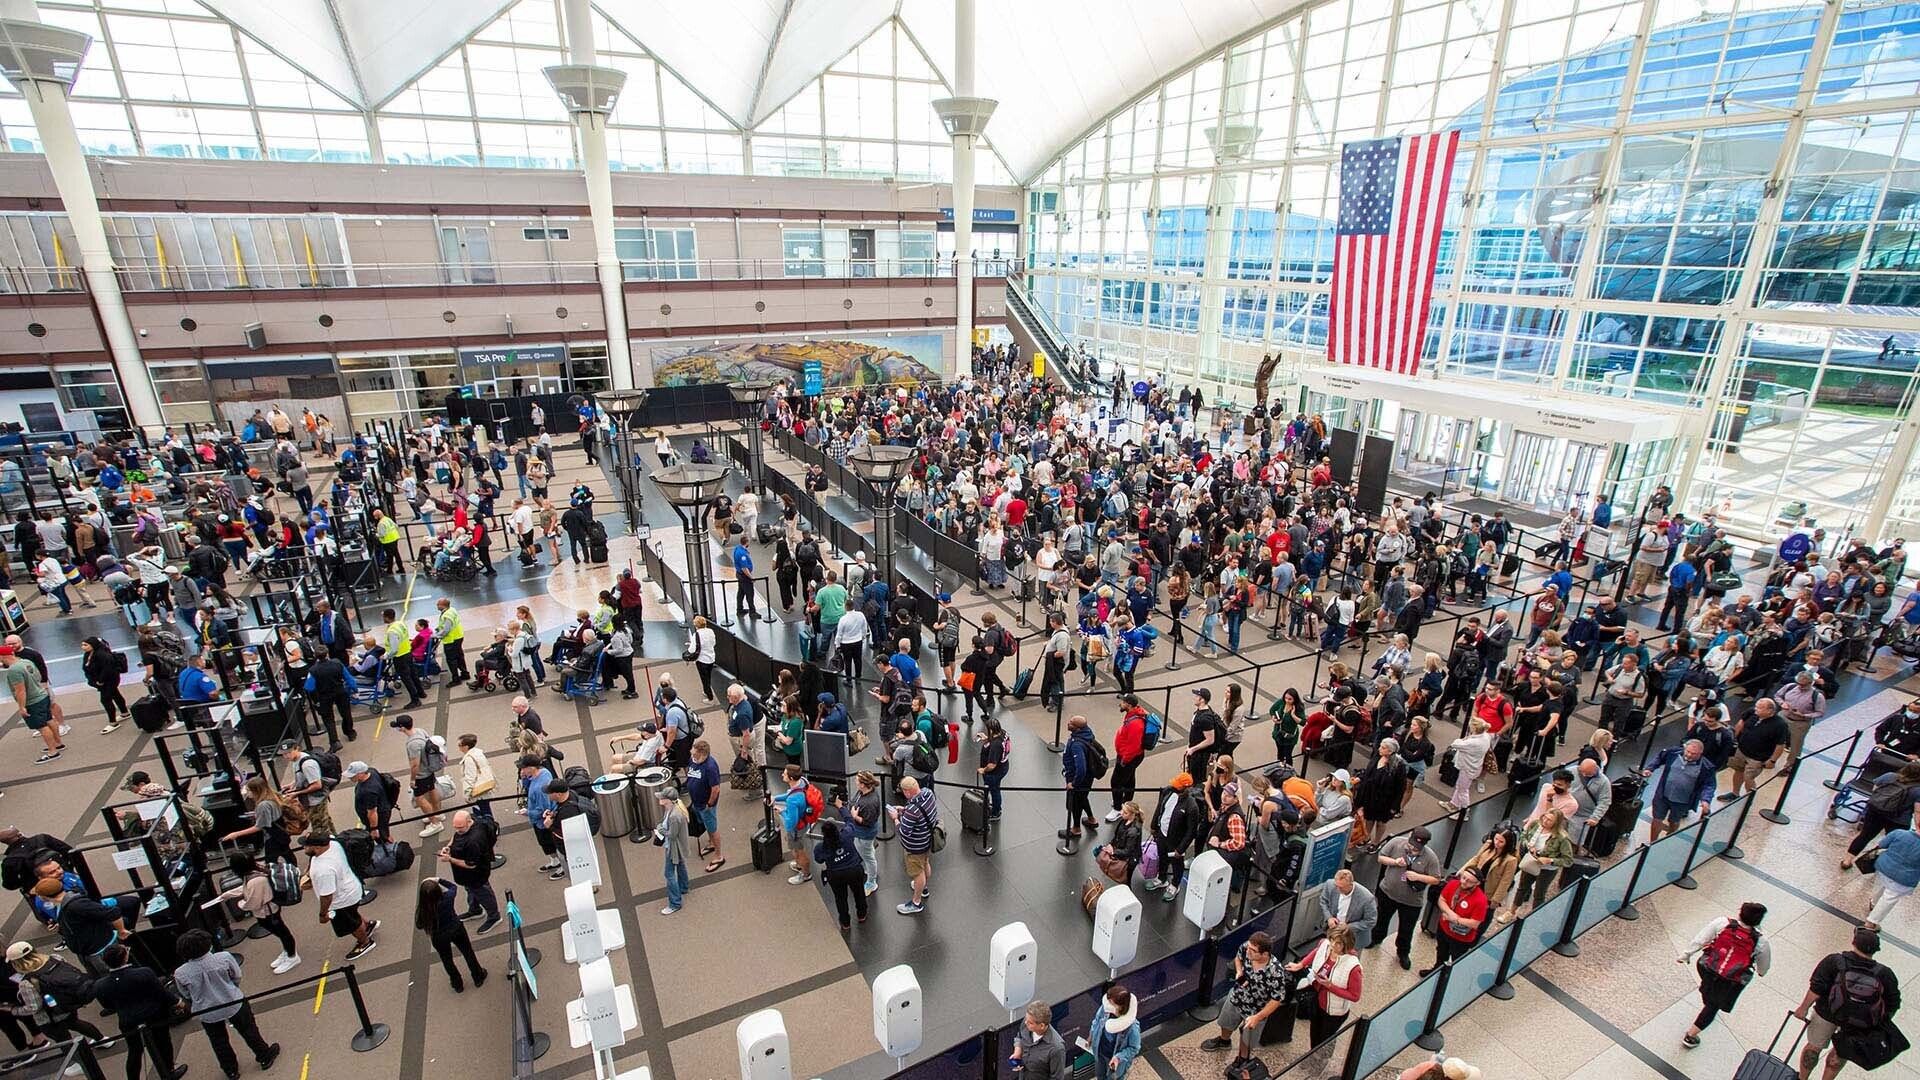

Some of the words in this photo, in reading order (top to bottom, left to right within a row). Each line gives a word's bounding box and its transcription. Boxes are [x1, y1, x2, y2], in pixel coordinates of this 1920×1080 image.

[474, 353, 491, 363] TSA
[492, 353, 506, 362] Pre
[576, 929, 594, 937] CLEAR
[593, 1012, 613, 1021] CLEAR
